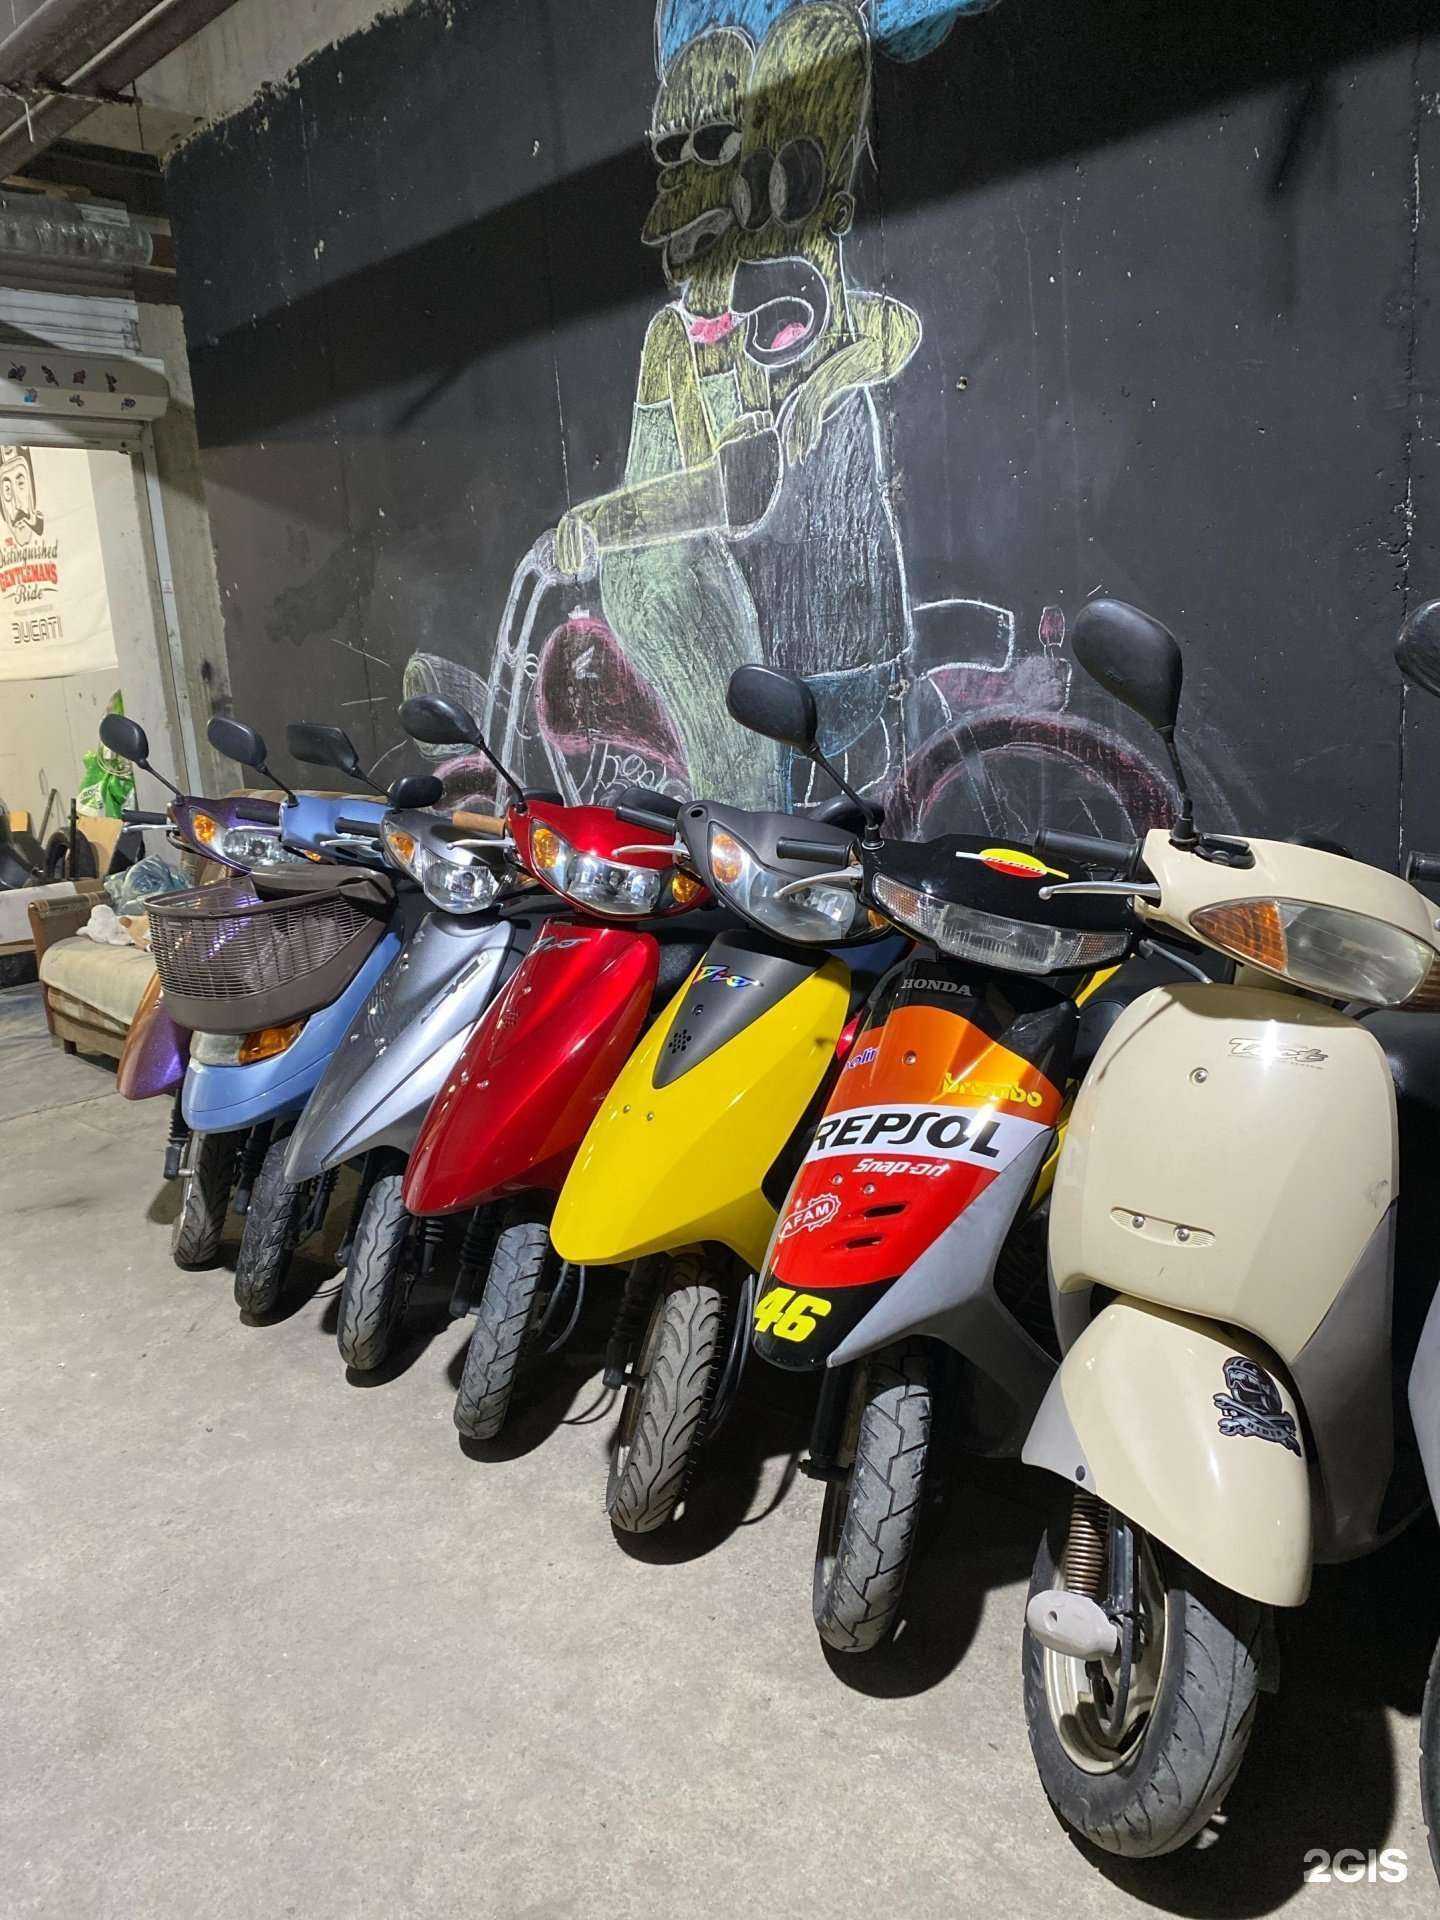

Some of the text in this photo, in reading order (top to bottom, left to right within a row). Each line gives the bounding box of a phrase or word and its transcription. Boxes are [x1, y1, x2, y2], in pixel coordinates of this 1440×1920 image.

[14, 584, 43, 605] Ride
[900, 978, 973, 998] HONDA
[813, 1111, 1002, 1159] REPSOL
[783, 1202, 830, 1232] AFAM
[754, 1286, 832, 1342] 46
